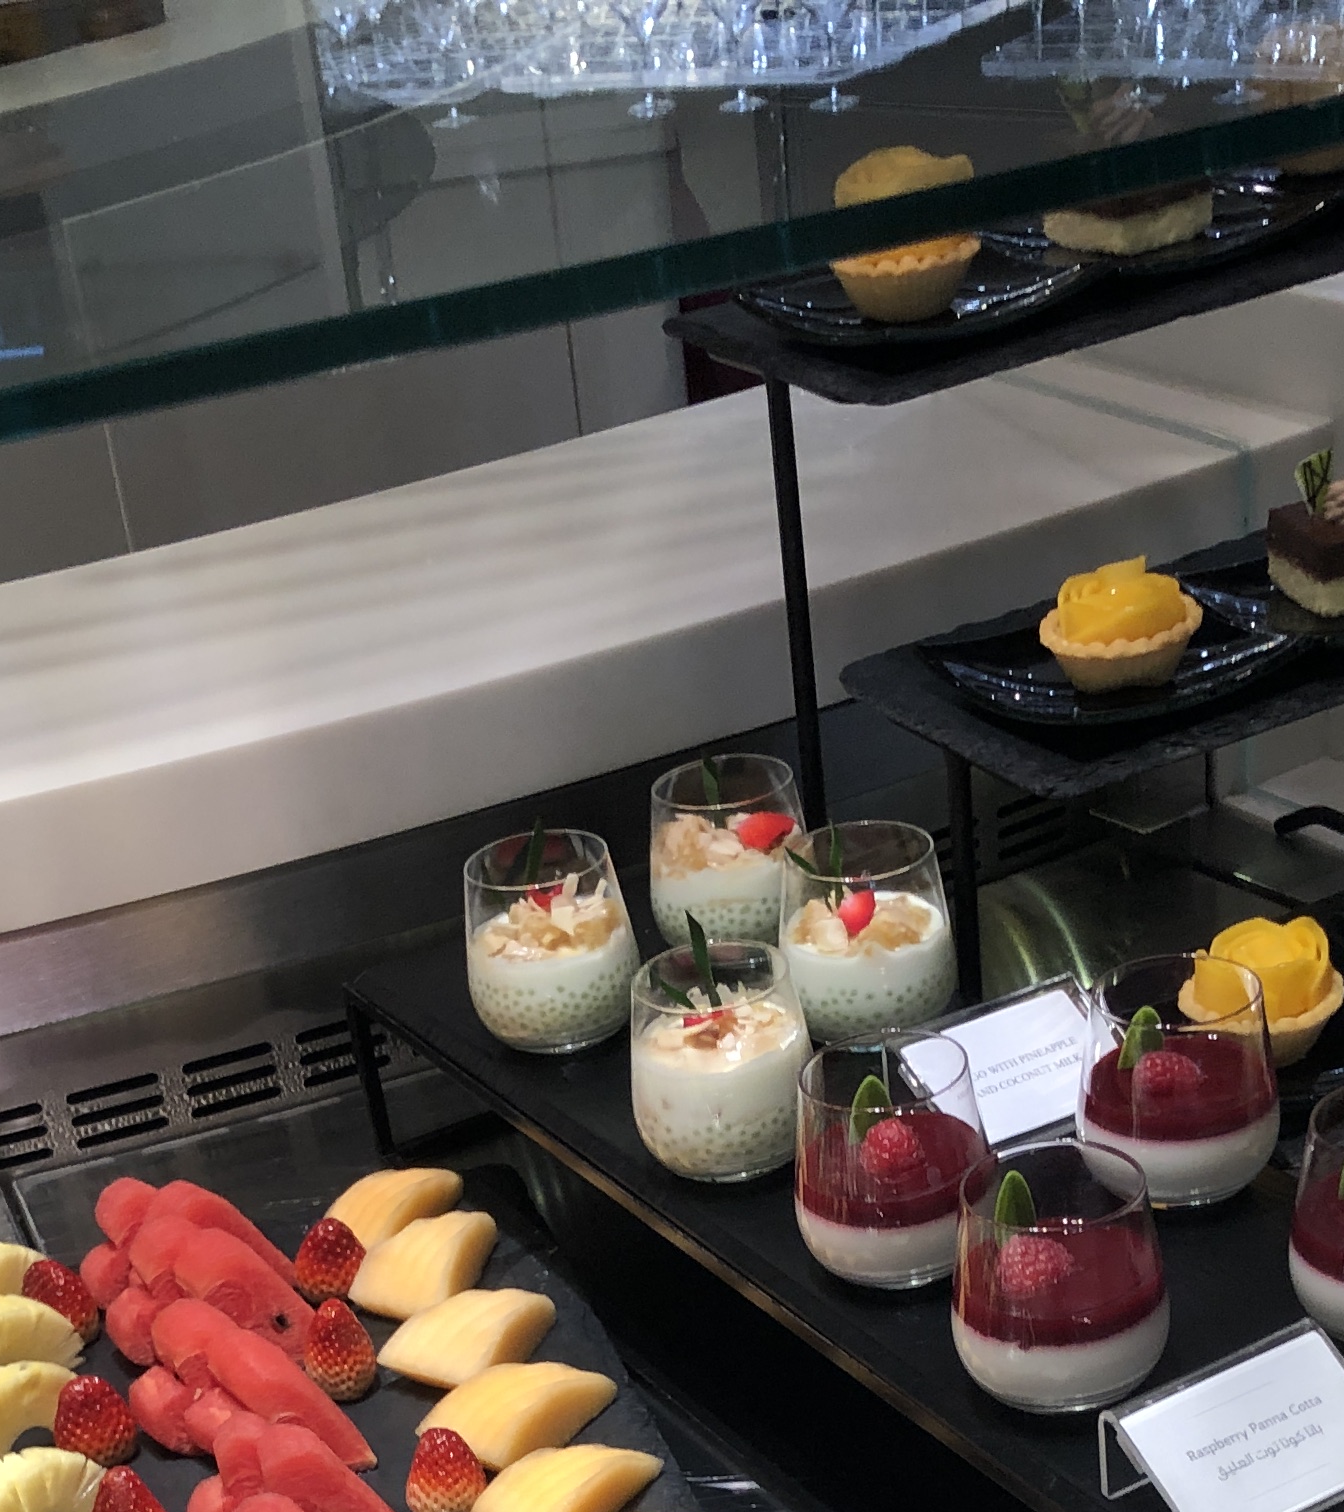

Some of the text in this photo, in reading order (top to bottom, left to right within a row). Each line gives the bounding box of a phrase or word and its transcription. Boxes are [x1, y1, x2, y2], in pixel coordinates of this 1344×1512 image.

[988, 1058, 1018, 1074] WITH
[1018, 1036, 1077, 1064] PINEAPPLE
[999, 1065, 1052, 1089] COCONUT
[1053, 1053, 1083, 1069] MILK
[1186, 1395, 1322, 1462] Raspberry Panna Cotta
